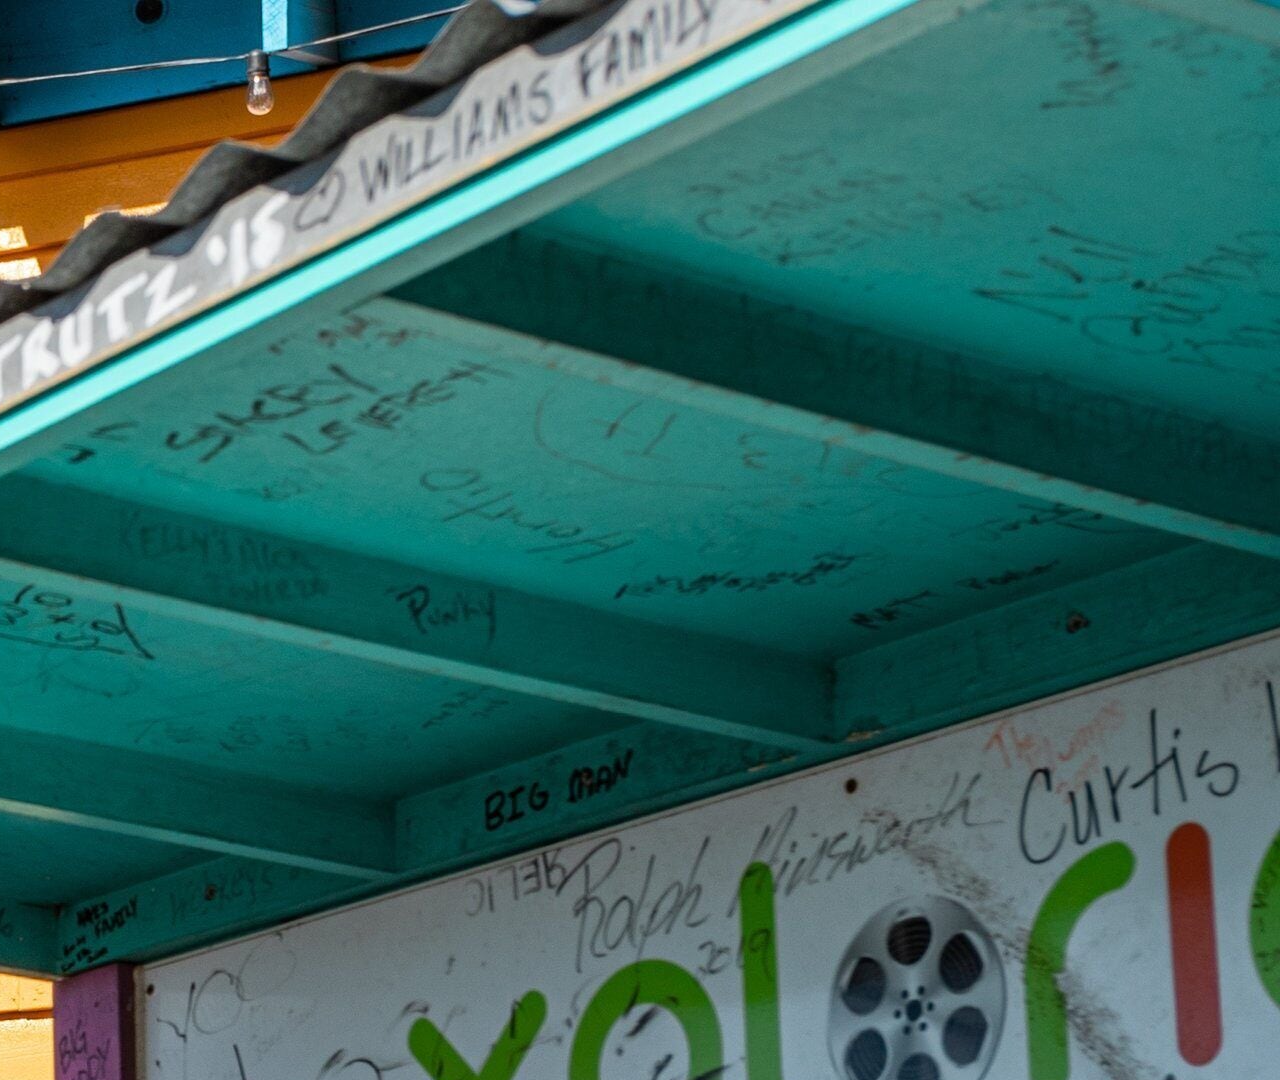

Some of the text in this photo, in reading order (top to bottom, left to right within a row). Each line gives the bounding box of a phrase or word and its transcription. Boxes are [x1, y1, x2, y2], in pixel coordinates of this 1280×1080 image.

[358, 68, 558, 204] WILLIAMS
[483, 781, 550, 832] BIG
[1019, 707, 1240, 866] Curtis
